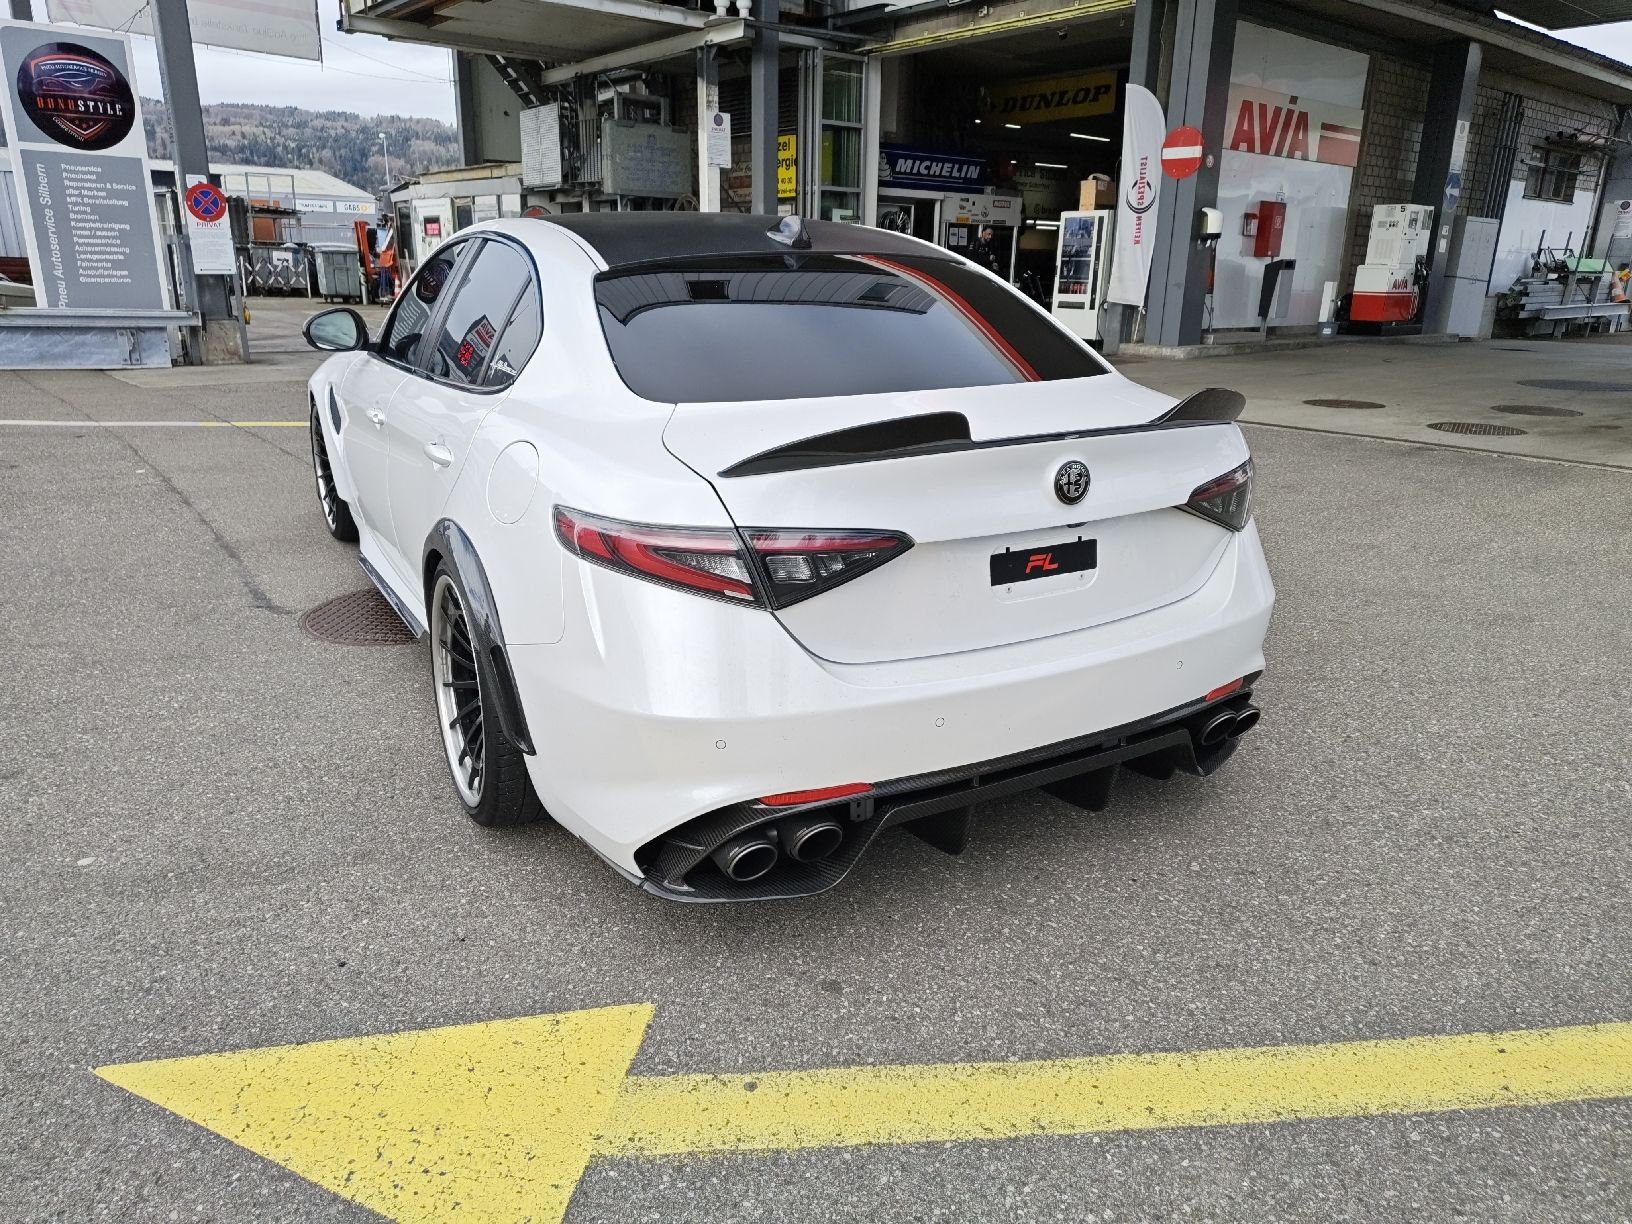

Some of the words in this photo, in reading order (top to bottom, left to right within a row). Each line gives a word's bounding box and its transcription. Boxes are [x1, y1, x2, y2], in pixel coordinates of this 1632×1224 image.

[999, 84, 1112, 114] DUNLOP
[1230, 95, 1310, 161] AVIA
[895, 158, 981, 179] MICHELIN
[37, 163, 52, 206] Silbern
[64, 179, 105, 189] Reparaturen
[112, 182, 137, 191] Service
[81, 189, 107, 197] Marken
[67, 204, 91, 213] Tuning
[69, 212, 100, 221] Bremsen
[70, 221, 130, 231] Komplettreinigung
[196, 221, 222, 229] PRIVAT
[44, 208, 65, 279] Autoservice
[73, 236, 121, 245] Pannenservice
[75, 244, 130, 254] Achsvermessung
[76, 253, 125, 261] Lenkgeometrie
[78, 268, 129, 278] Auspuffanlagen
[1391, 276, 1408, 291] AVIA
[1025, 553, 1059, 574] FL
